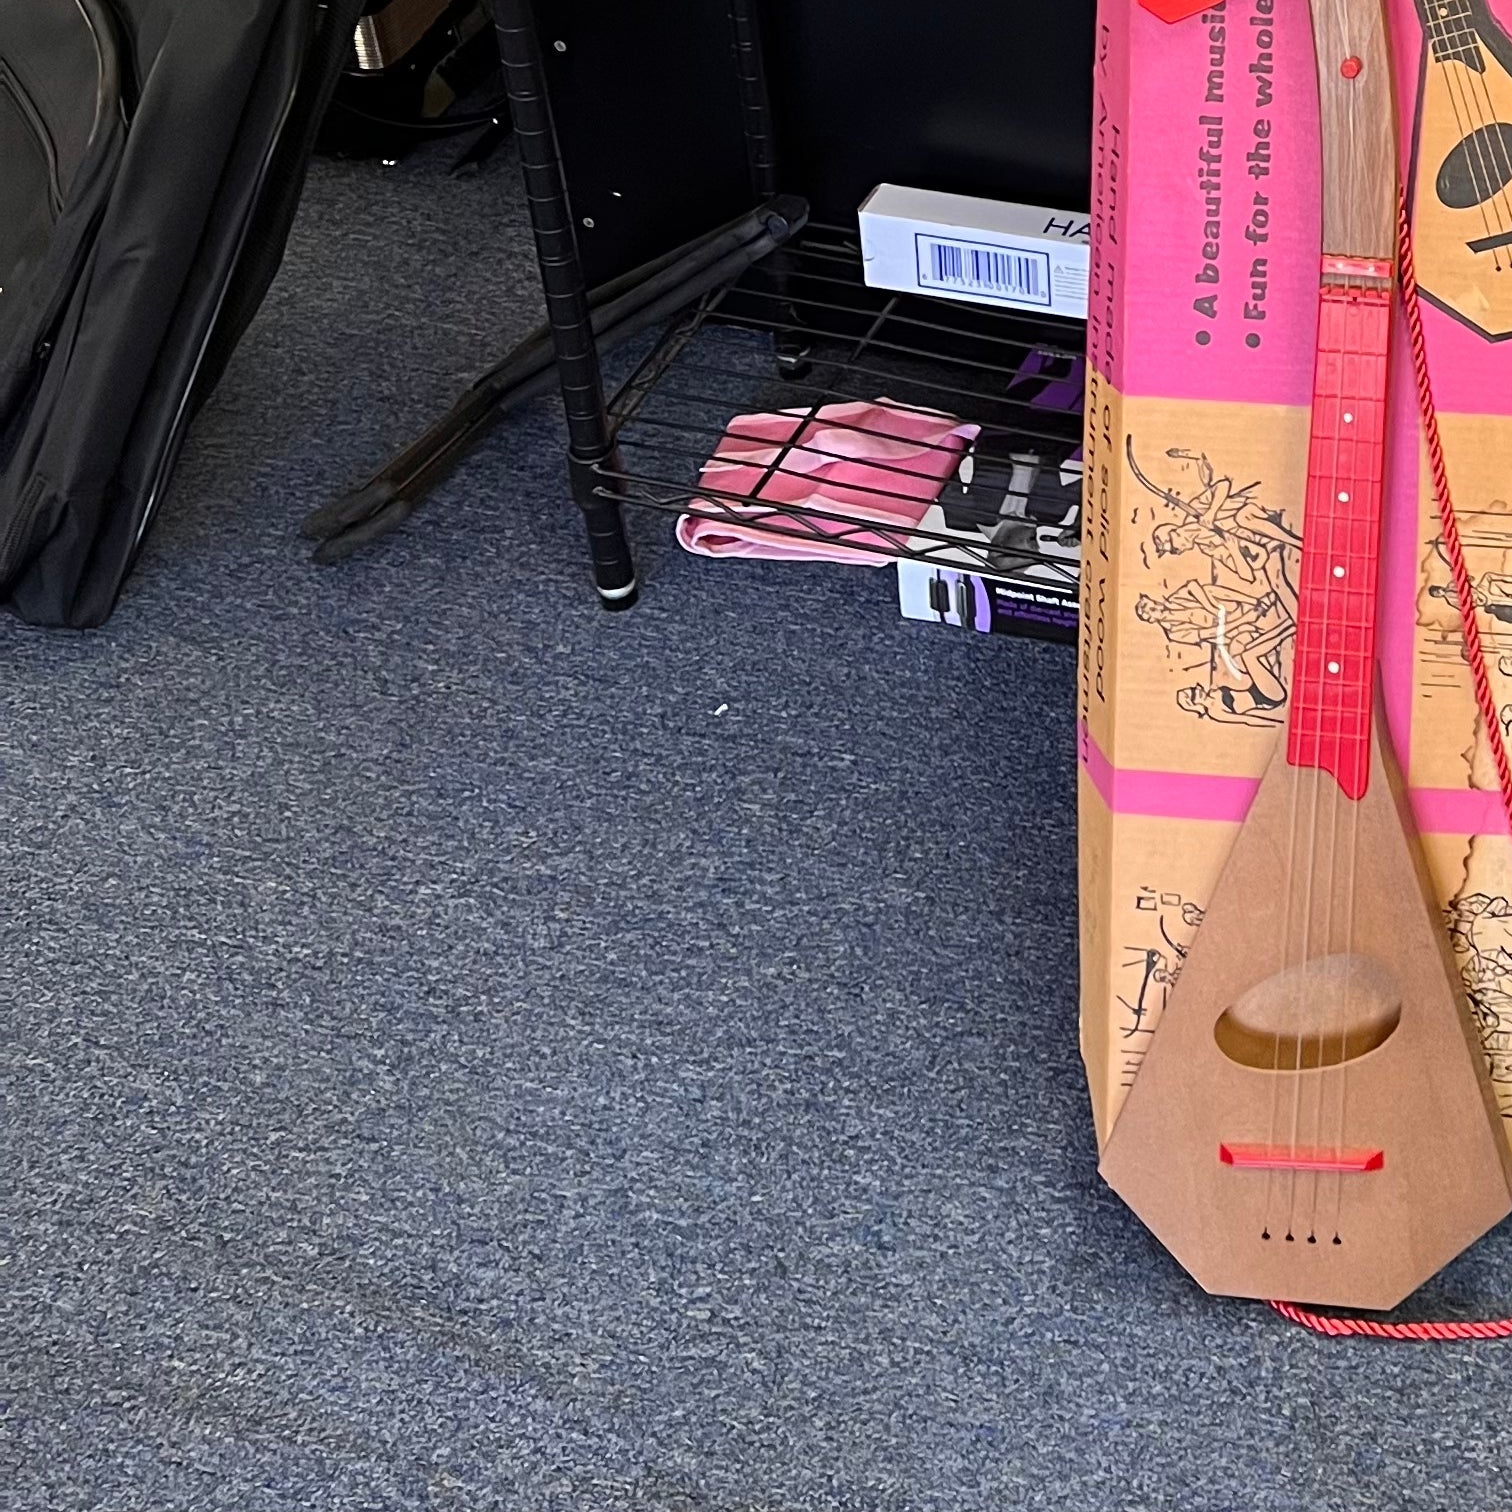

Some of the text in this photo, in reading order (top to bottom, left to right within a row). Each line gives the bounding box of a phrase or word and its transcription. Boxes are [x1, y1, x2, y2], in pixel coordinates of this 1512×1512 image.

[1100, 24, 1110, 78] by
[1246, 118, 1272, 181] the
[1093, 91, 1108, 297] American
[1195, 115, 1224, 286] beautiful
[1244, 190, 1270, 248] for
[1193, 292, 1219, 319] A
[1243, 256, 1269, 321] Fun
[1096, 124, 1121, 704] Hand made of solid wood
[1081, 560, 1092, 764] craftsmen
